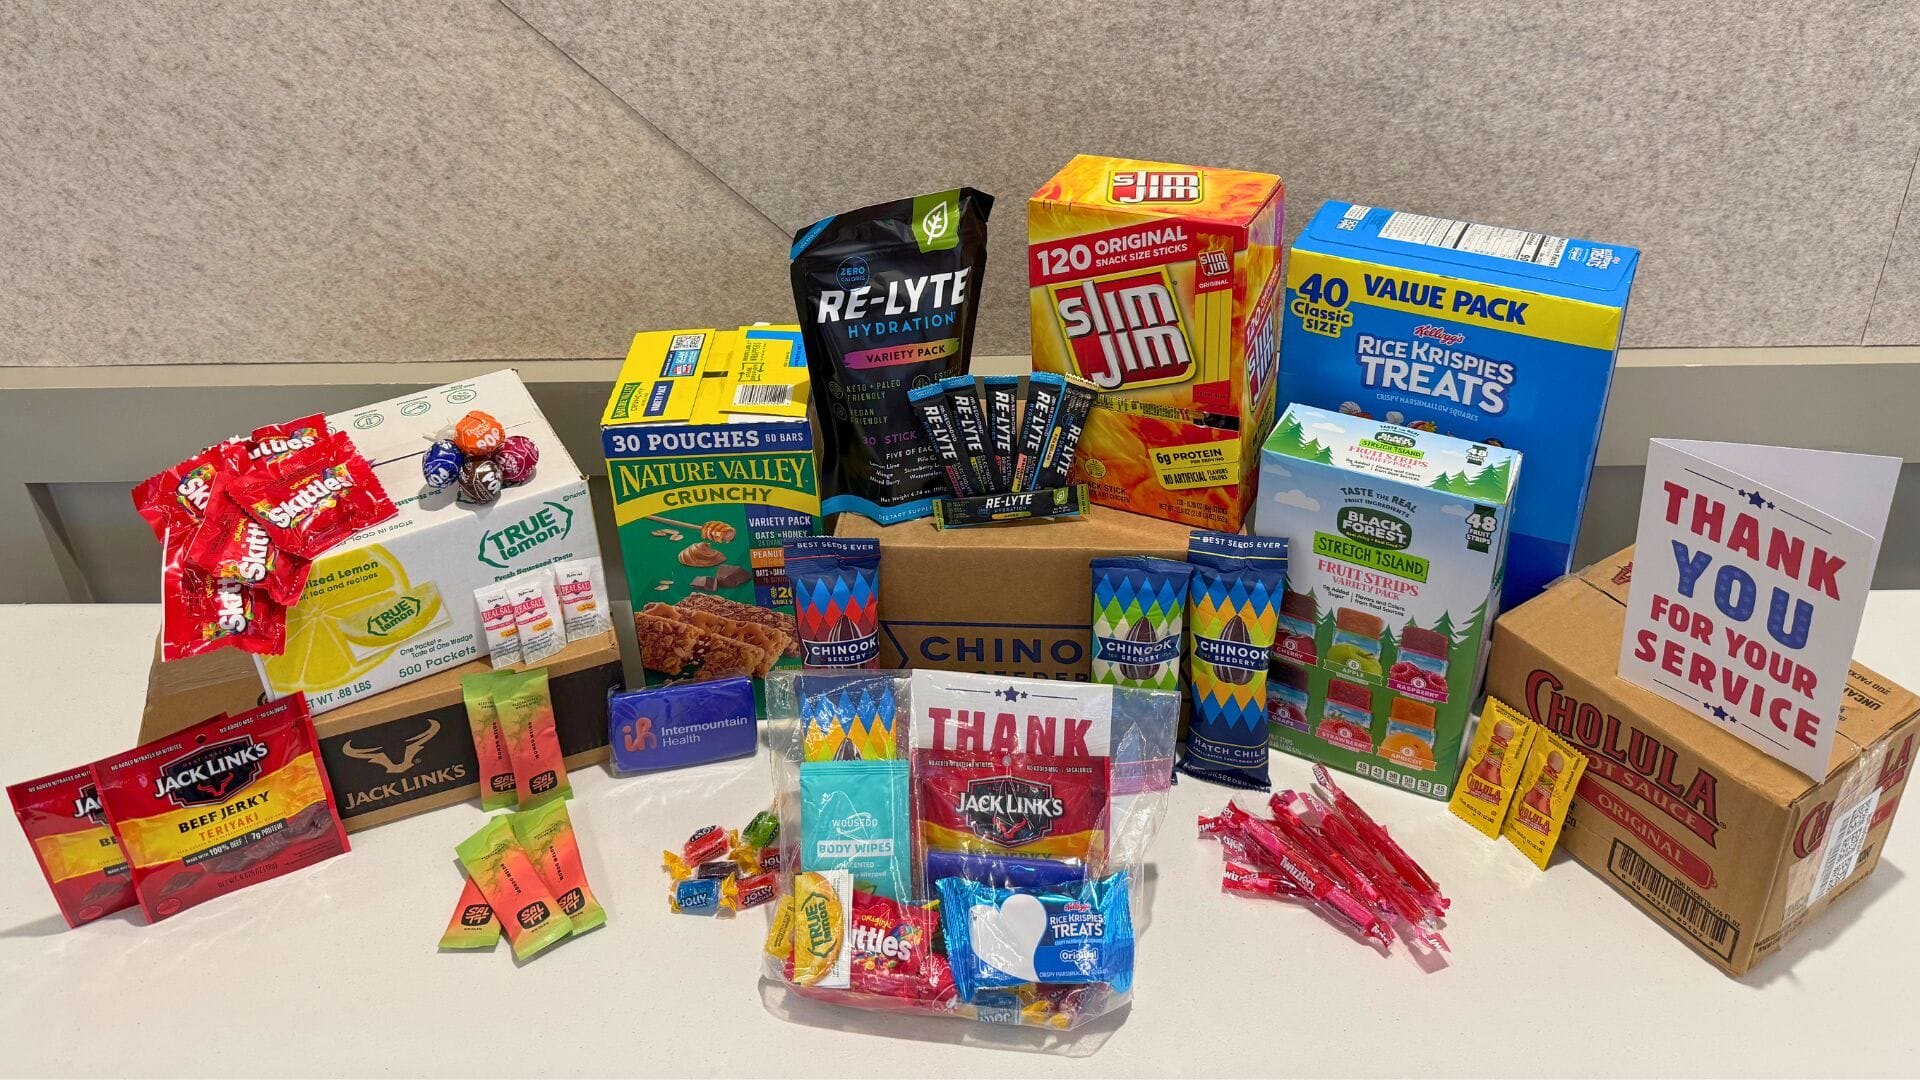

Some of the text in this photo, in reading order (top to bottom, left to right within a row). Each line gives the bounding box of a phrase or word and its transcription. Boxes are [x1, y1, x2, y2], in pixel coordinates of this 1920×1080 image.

[1095, 226, 1187, 255] ORIGINAL
[1038, 245, 1091, 275] 120
[1096, 244, 1187, 267] SNACK SIZE STICKS
[841, 266, 865, 276] ZERO
[817, 267, 971, 323] RE-LYTE
[1199, 279, 1228, 289] ORIGINAL
[1300, 273, 1348, 307] 40
[1364, 274, 1529, 325] VALUE PACK
[1294, 301, 1350, 324] Classic
[848, 314, 954, 338] HYDRATION
[1306, 319, 1337, 334] SIZE
[1414, 324, 1465, 345] Kellogg's
[866, 344, 945, 363] VARIETY PACK
[1358, 335, 1514, 384] RICE KRISPIES
[1361, 355, 1504, 414] TREATS
[1376, 393, 1478, 422] CRISPY MARSHMALLOW SQUARES
[924, 406, 958, 460] RE-LYTE
[955, 396, 983, 452] RE-LYTE
[995, 391, 1010, 453] RE-LYTE
[1027, 391, 1050, 452] RE-LYTE
[612, 431, 804, 452] 30 POUCHES 60 BARS
[1057, 424, 1081, 477] RE-LYTE
[1156, 448, 1223, 465] 6g PROTEIN
[618, 457, 807, 497] NATURE VALLEY
[1163, 474, 1173, 485] NO
[1174, 471, 1207, 484] ARTIFICIAL
[663, 487, 772, 507] CRUNCHY
[986, 494, 1033, 508] RE-LYTE
[1104, 484, 1126, 495] STICK
[1341, 488, 1373, 497] TASTE
[1392, 496, 1417, 513] REAL
[269, 476, 353, 528] Skittles
[1365, 499, 1410, 517] INGREDIENTS
[488, 508, 556, 549] TRUE
[749, 516, 811, 527] VARIETY PACK
[1342, 520, 1406, 544] FOREST
[1348, 511, 1403, 533] BLACK
[1466, 513, 1496, 532] 48
[1470, 528, 1490, 538] FRUIT
[499, 527, 561, 561] lemon
[755, 530, 807, 540] OATS HONEY
[822, 542, 848, 550] SEEDS
[1202, 536, 1281, 550] BEST SEEDS EVER
[1466, 533, 1491, 545] STRIPS
[1663, 480, 1847, 601] THANK
[753, 550, 782, 558] PEANUT
[1318, 537, 1423, 576] STRETCH ISLAND
[338, 561, 378, 579] Lemon
[494, 552, 573, 582] Fresh Squeezed Taste
[1318, 560, 1418, 597] FRUIT STRIPS
[310, 573, 378, 598] tea and recipes
[1328, 591, 1344, 600] Sugar
[1332, 587, 1349, 596] Added
[1333, 576, 1400, 600] VARIETY PACK
[1671, 539, 1814, 650] YOU
[371, 600, 412, 626] TRUE
[1356, 594, 1405, 611] Flavors Colors
[1383, 606, 1404, 616] Sources
[380, 608, 415, 633] lemon
[400, 639, 436, 656] One Packet
[411, 634, 473, 659] Taste of One Wedge
[811, 637, 876, 656] CHINOOK
[827, 653, 866, 662] SEEDERY
[920, 636, 1083, 665] CHINO
[1106, 639, 1172, 657] CHINOOK
[1121, 654, 1159, 662] SEEDERY
[1200, 640, 1269, 661] CHINOOK
[1276, 646, 1304, 660] CHERRY
[1651, 594, 1818, 700] FOR YOUR
[400, 645, 476, 678] 500 Packets
[1215, 655, 1256, 667] SEEDERY
[1342, 668, 1364, 677] APPLE
[316, 680, 372, 705] WT .88 LBS
[1396, 683, 1440, 698] RASPBERRY
[1634, 629, 1821, 748] SERVICE
[661, 716, 748, 736] Intermountain
[929, 707, 1092, 756] THANK
[1271, 714, 1294, 726] GRAPE
[662, 734, 701, 747] Health
[1195, 737, 1265, 759] HATCH CHILE
[1321, 731, 1368, 749] STRAWBERRY
[1525, 669, 1719, 825] CHOLULA
[155, 742, 268, 797] JACK LINK'S
[1391, 753, 1422, 765] APRICOT
[345, 764, 466, 810] JACK LINK'S
[1588, 754, 1698, 830] OT SAUCE
[178, 791, 270, 833] BEEF JERKY
[956, 793, 1063, 817] JACK LINK'S
[199, 812, 260, 841] TERIYAKI
[832, 818, 878, 828] WOUSEDO
[1599, 794, 1684, 865] ORIGINAL
[209, 844, 230, 857] 100%
[230, 839, 242, 849] BEEF
[251, 832, 261, 841] 7g
[262, 822, 284, 837] PROTEIN
[819, 842, 892, 854] BODY WIPES
[1280, 855, 1315, 891] Twizzlers
[681, 894, 707, 907] JOLLY
[744, 886, 773, 904] JOLLY
[805, 903, 823, 949] TRUE
[817, 900, 832, 944] lemon
[1050, 914, 1104, 925] RICE KRISPIES
[1053, 923, 1103, 938] TREATS
